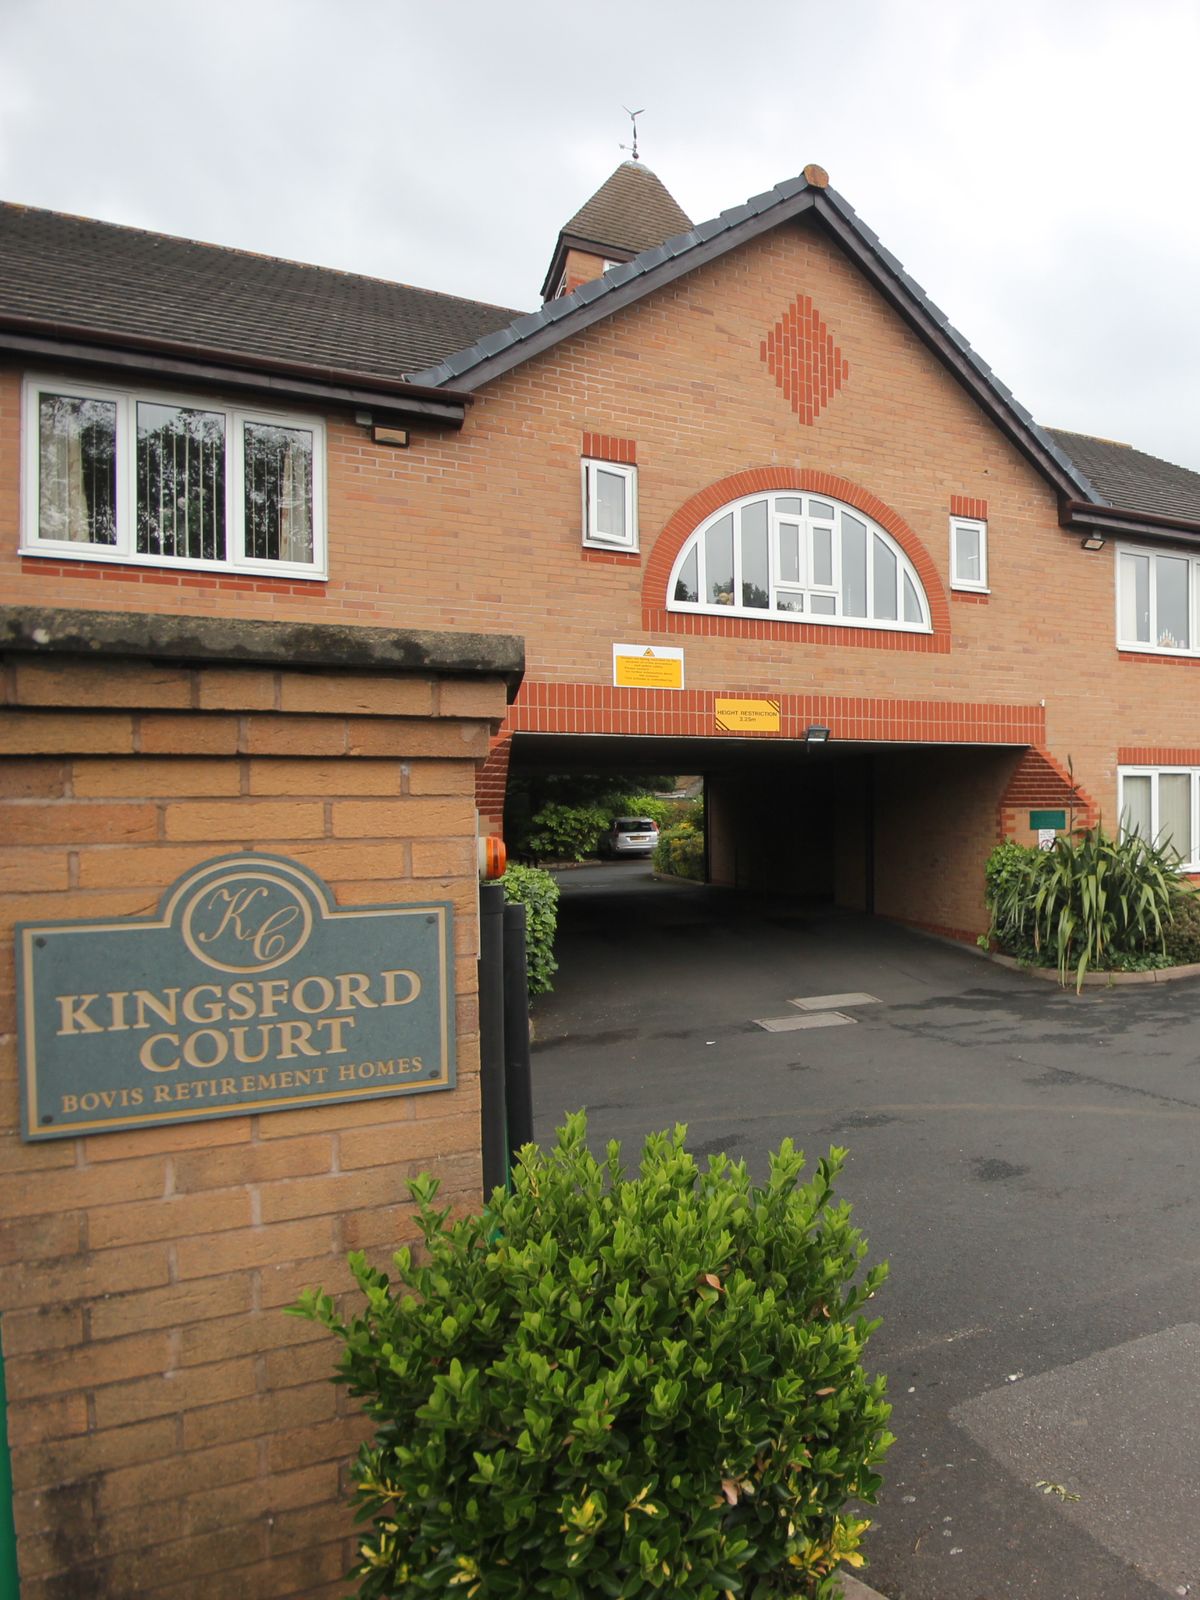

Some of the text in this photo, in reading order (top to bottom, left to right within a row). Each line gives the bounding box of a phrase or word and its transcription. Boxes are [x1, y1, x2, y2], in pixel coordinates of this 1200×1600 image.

[55, 968, 423, 1036] KINGSFORD
[139, 1015, 355, 1073] COURT
[61, 1055, 424, 1114] BOVIS RETIREMENT HOMES
